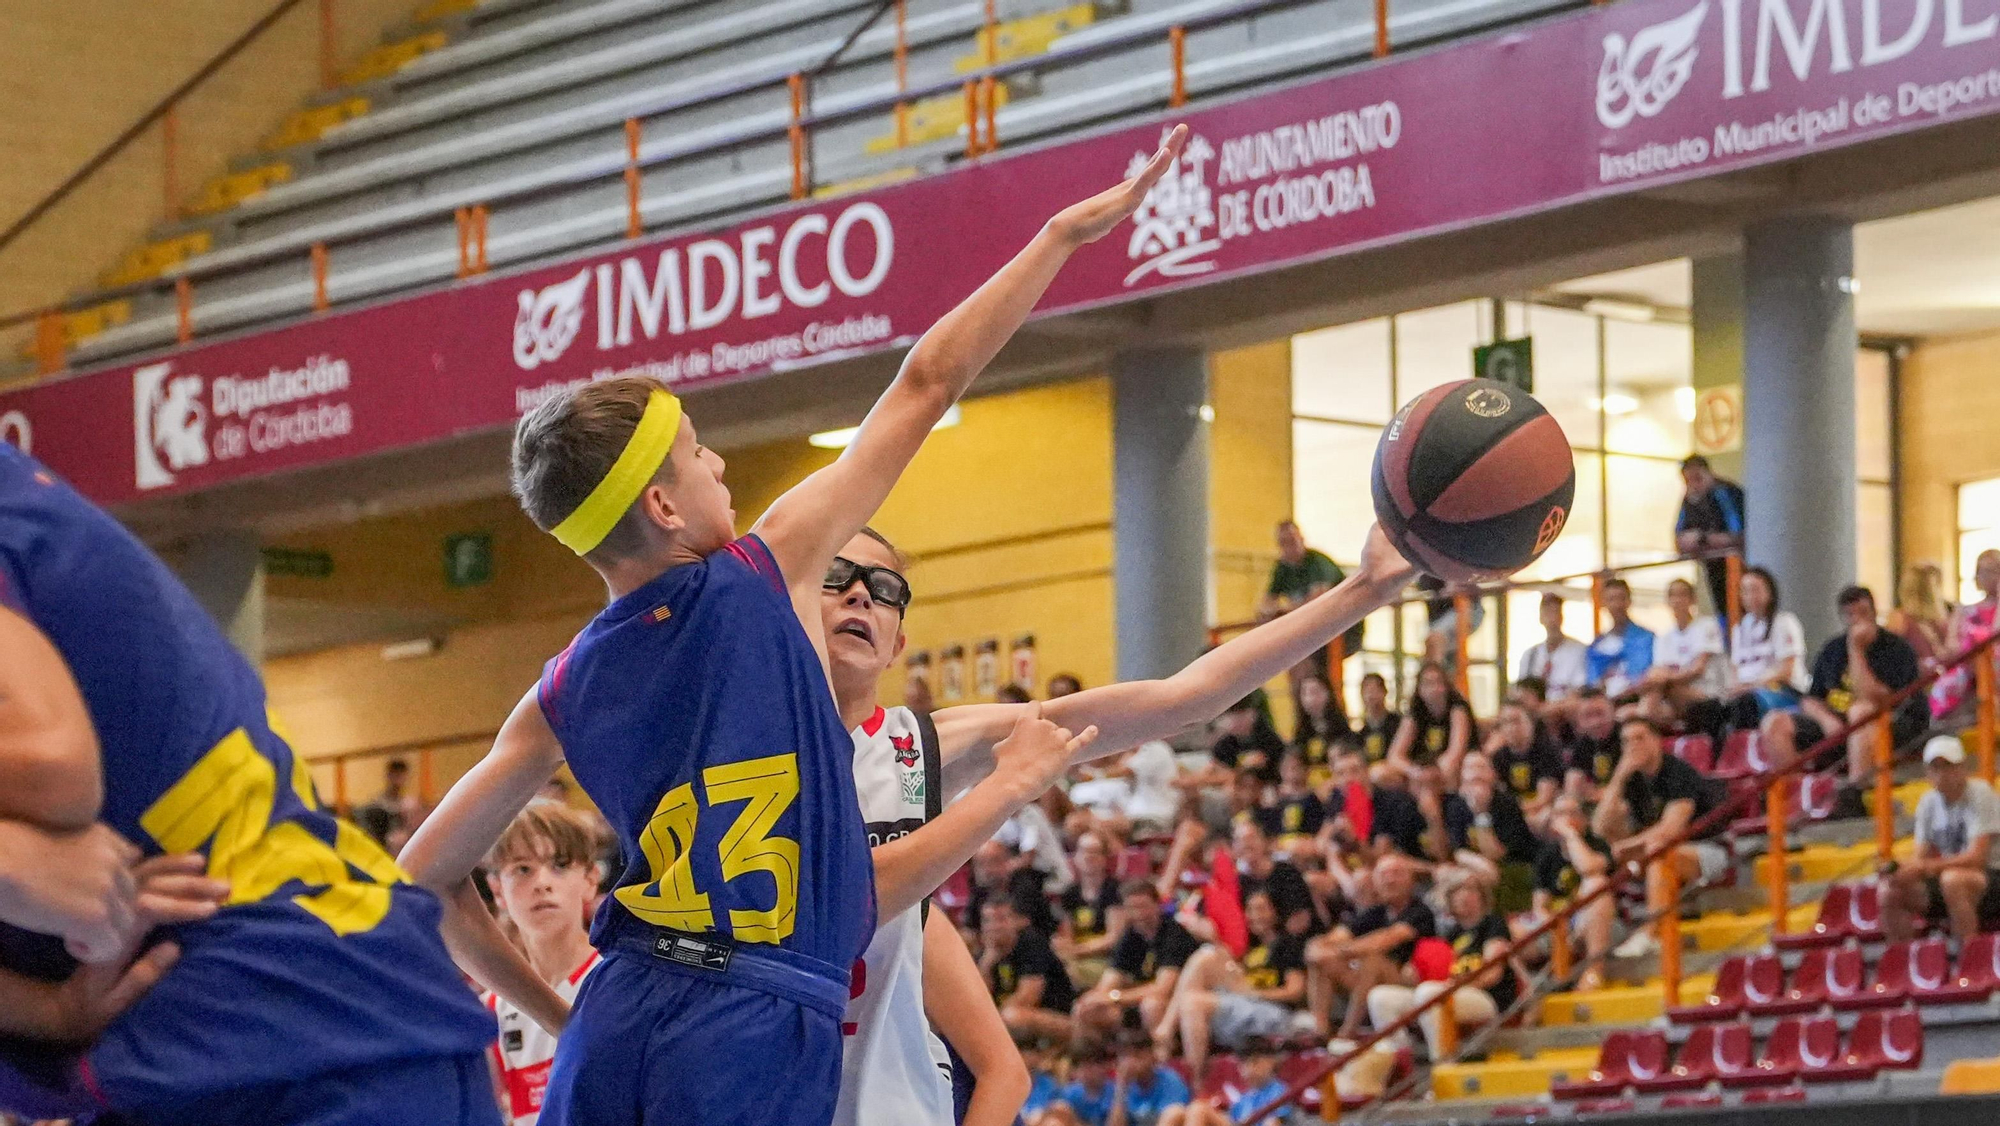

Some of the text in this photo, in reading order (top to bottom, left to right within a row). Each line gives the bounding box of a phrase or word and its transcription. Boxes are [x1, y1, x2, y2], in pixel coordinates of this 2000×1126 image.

[1217, 100, 1401, 186] AYUNTAMIENTO
[1600, 136, 1710, 183] Instituto
[1713, 96, 1849, 158] Municipal
[1853, 92, 1893, 127] de
[1218, 162, 1376, 240] DE CÓRDOBA
[596, 201, 894, 350] IMDECO
[212, 353, 350, 419] Diputación
[213, 401, 352, 460] de Córdoba
[614, 753, 801, 945] 43
